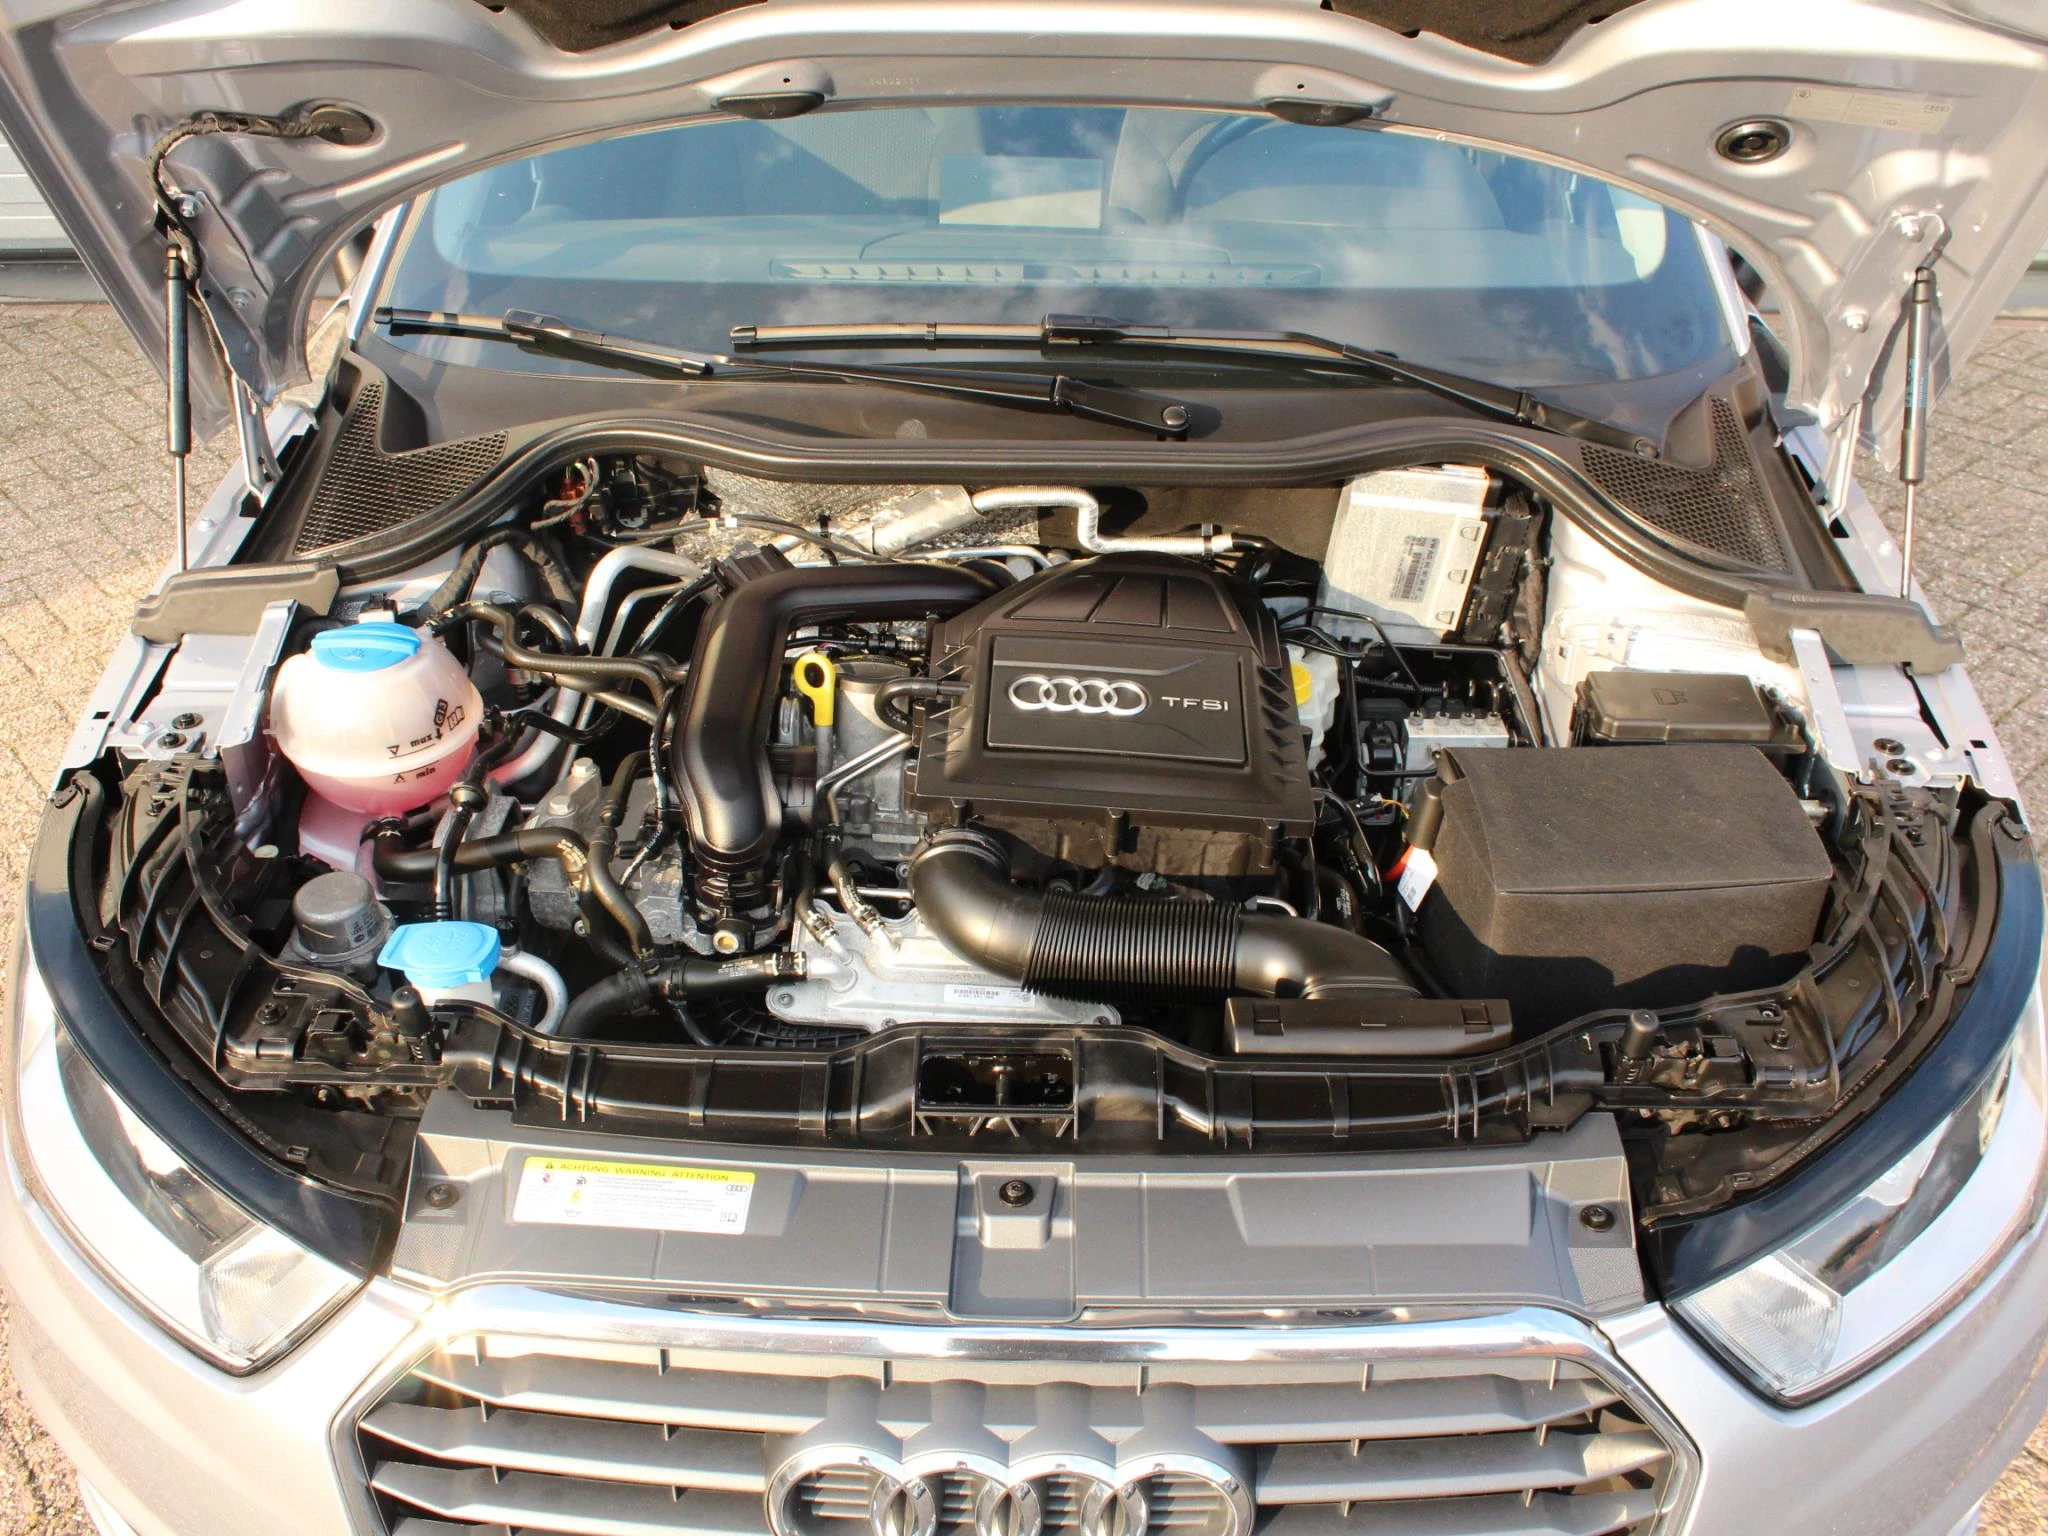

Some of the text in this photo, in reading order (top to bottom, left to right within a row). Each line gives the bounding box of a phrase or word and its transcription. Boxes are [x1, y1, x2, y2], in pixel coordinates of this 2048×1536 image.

[1161, 696, 1229, 711] TFSI
[410, 734, 433, 747] max
[416, 767, 435, 779] min
[560, 1163, 729, 1181] ACHTUNG WARNING ATTENTION
